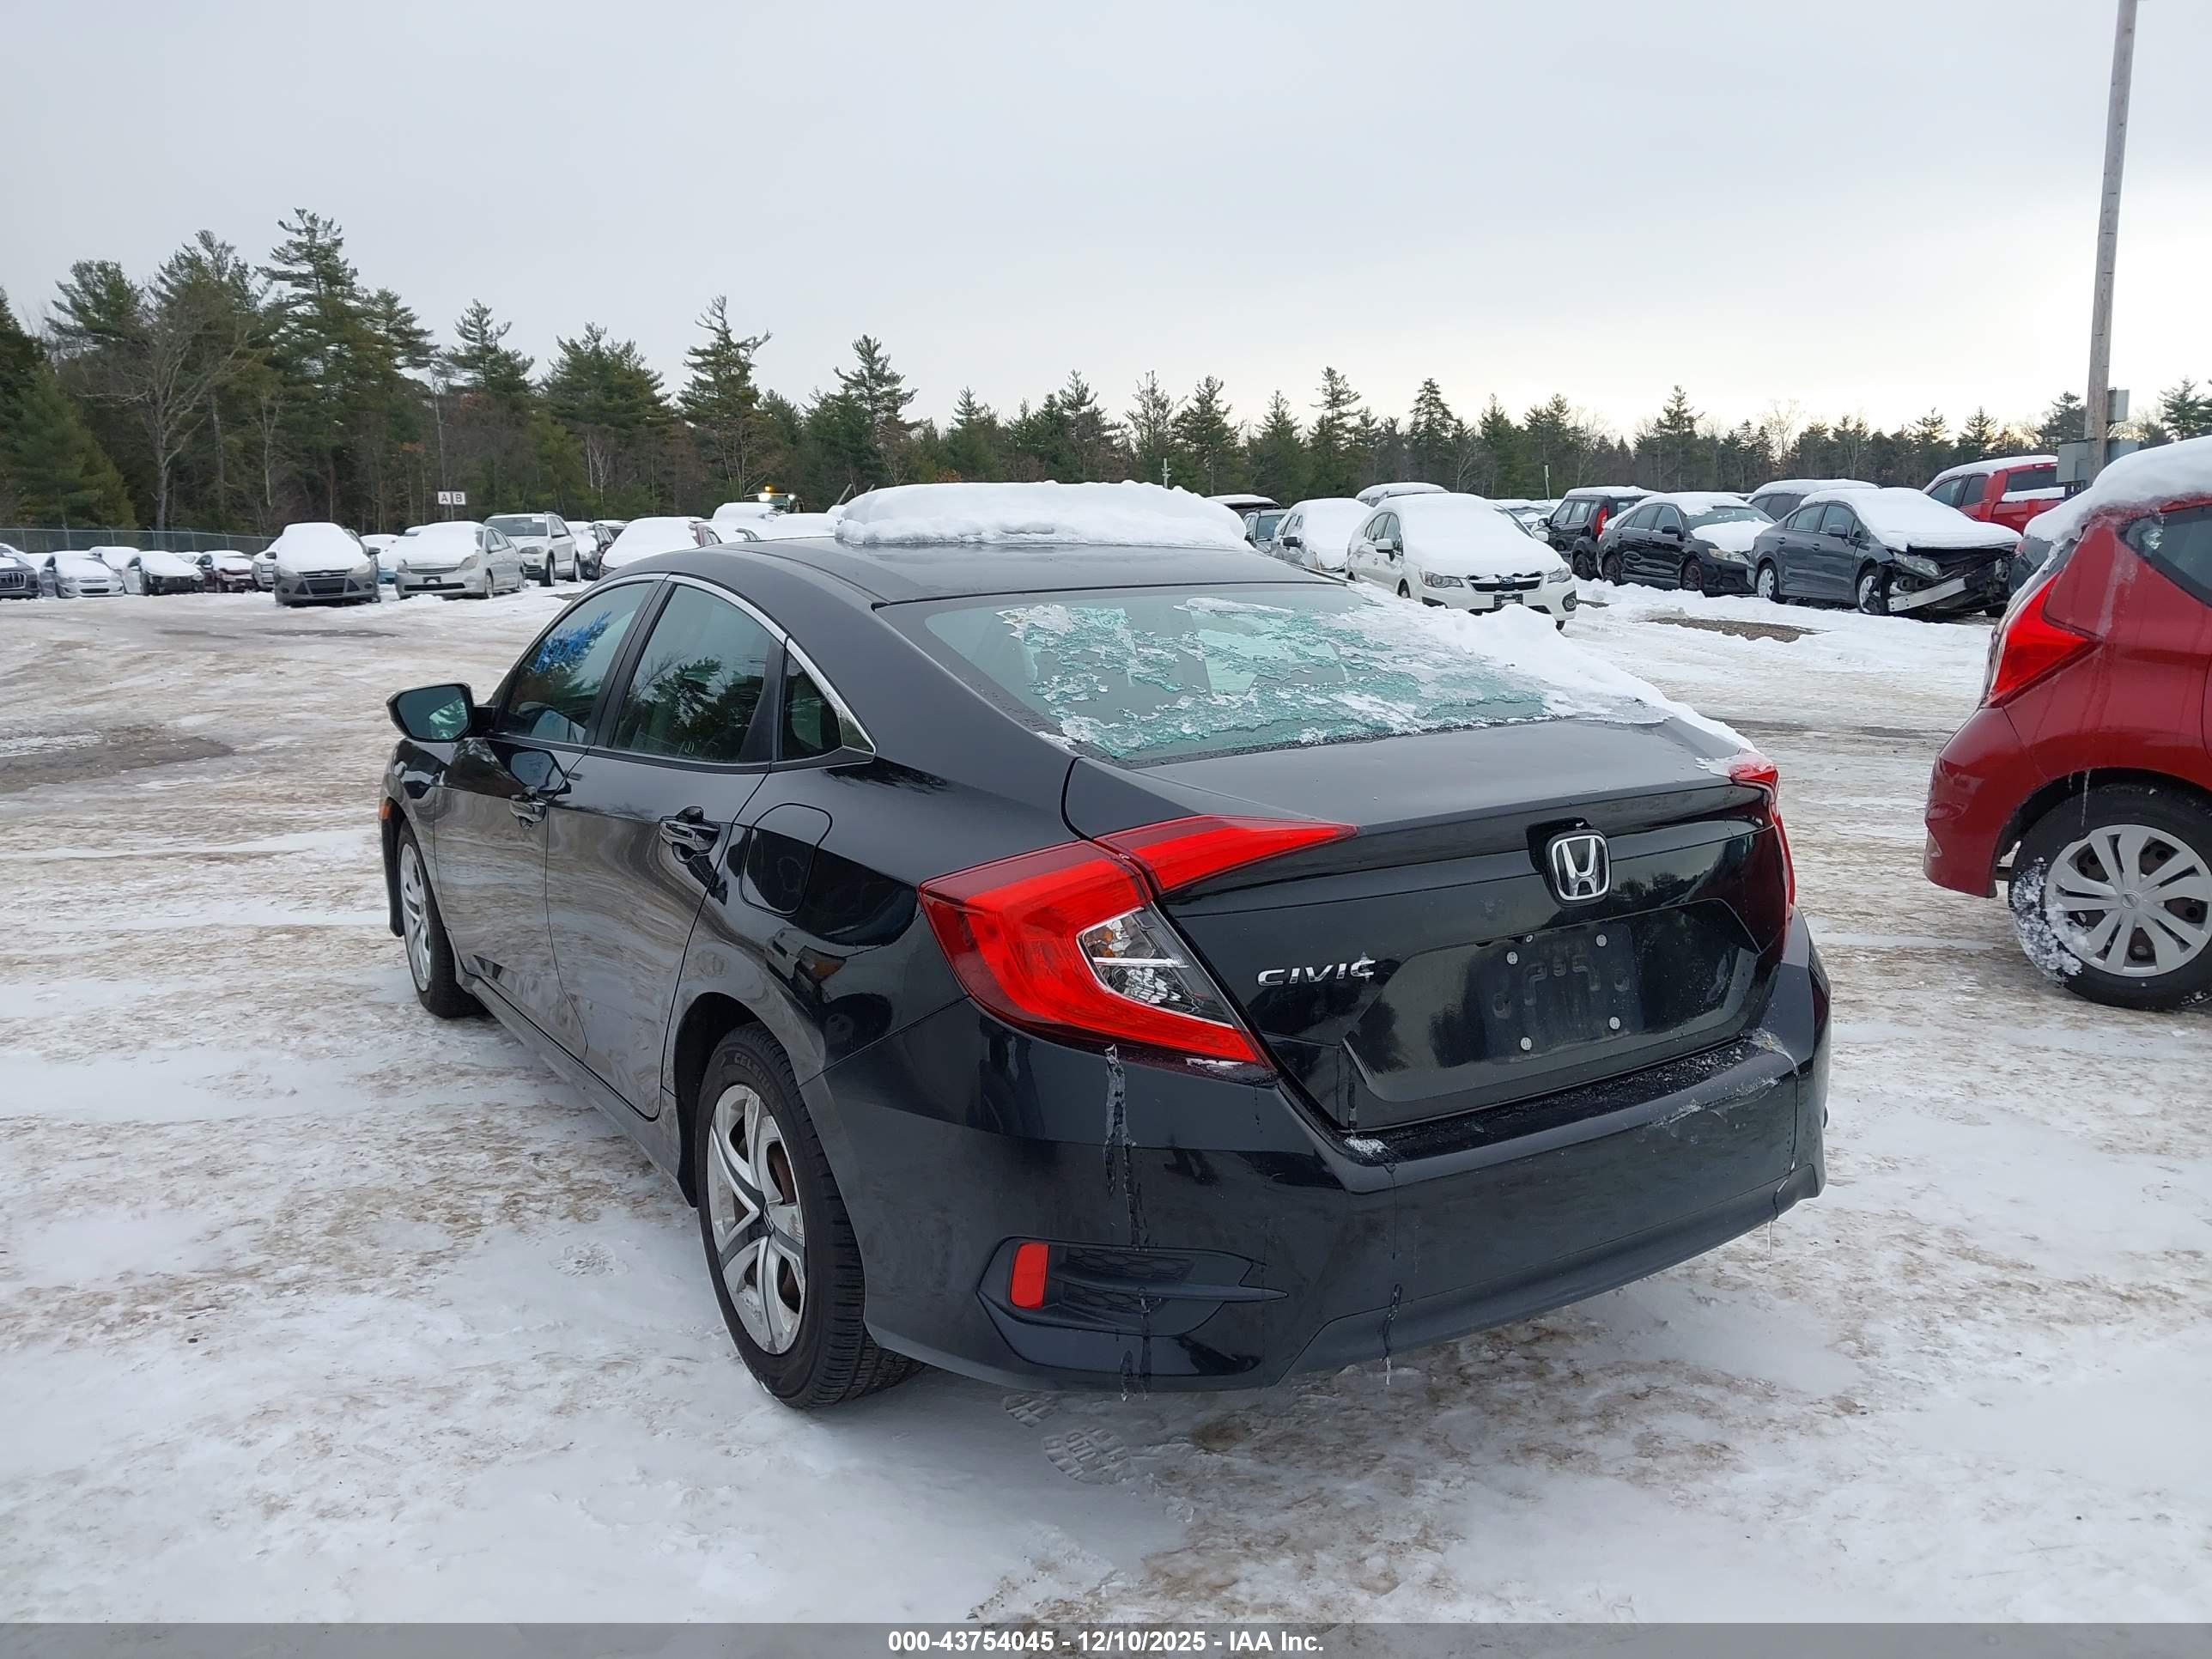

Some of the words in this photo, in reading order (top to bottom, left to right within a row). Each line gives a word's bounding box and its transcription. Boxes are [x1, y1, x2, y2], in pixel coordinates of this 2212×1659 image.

[441, 493, 448, 502] A
[455, 493, 463, 502] B
[1257, 959, 1376, 987] CIVIC
